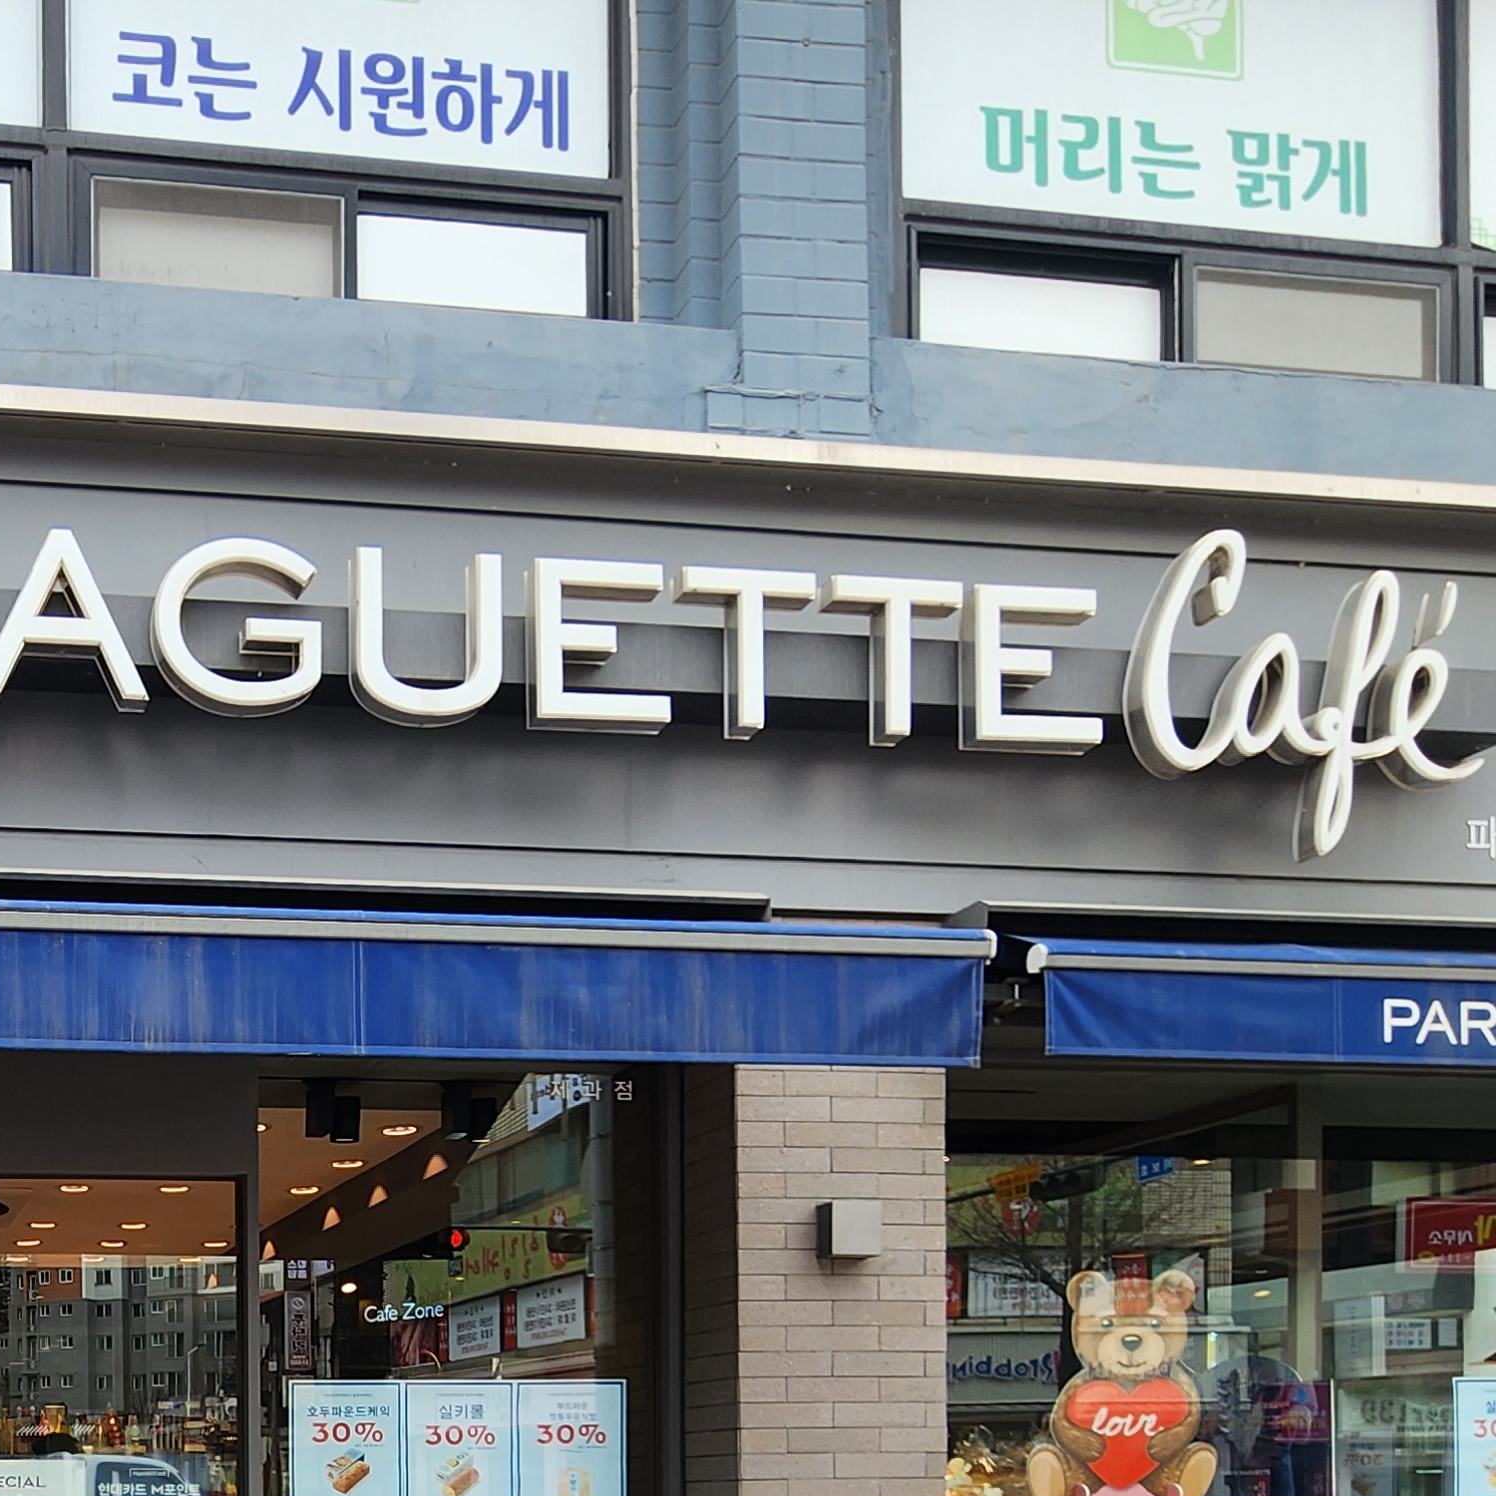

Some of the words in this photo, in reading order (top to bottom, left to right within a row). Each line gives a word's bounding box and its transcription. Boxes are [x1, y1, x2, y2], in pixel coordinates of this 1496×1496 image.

[112, 31, 257, 121] 코는
[288, 46, 570, 152] 시원하게
[979, 105, 1201, 200] 머리는
[1226, 128, 1368, 217] 맑게
[1122, 528, 1486, 862] Café
[363, 1304, 398, 1323] Cafe
[402, 1302, 444, 1321] Zone
[307, 1405, 390, 1418] 호두파운드케익
[439, 1404, 484, 1420] 실키롤
[312, 1422, 383, 1443] 30%
[425, 1425, 495, 1446] 30%
[536, 1424, 606, 1444] 30%
[97, 1483, 148, 1496] 현대카드
[151, 1483, 201, 1496] M포인트
